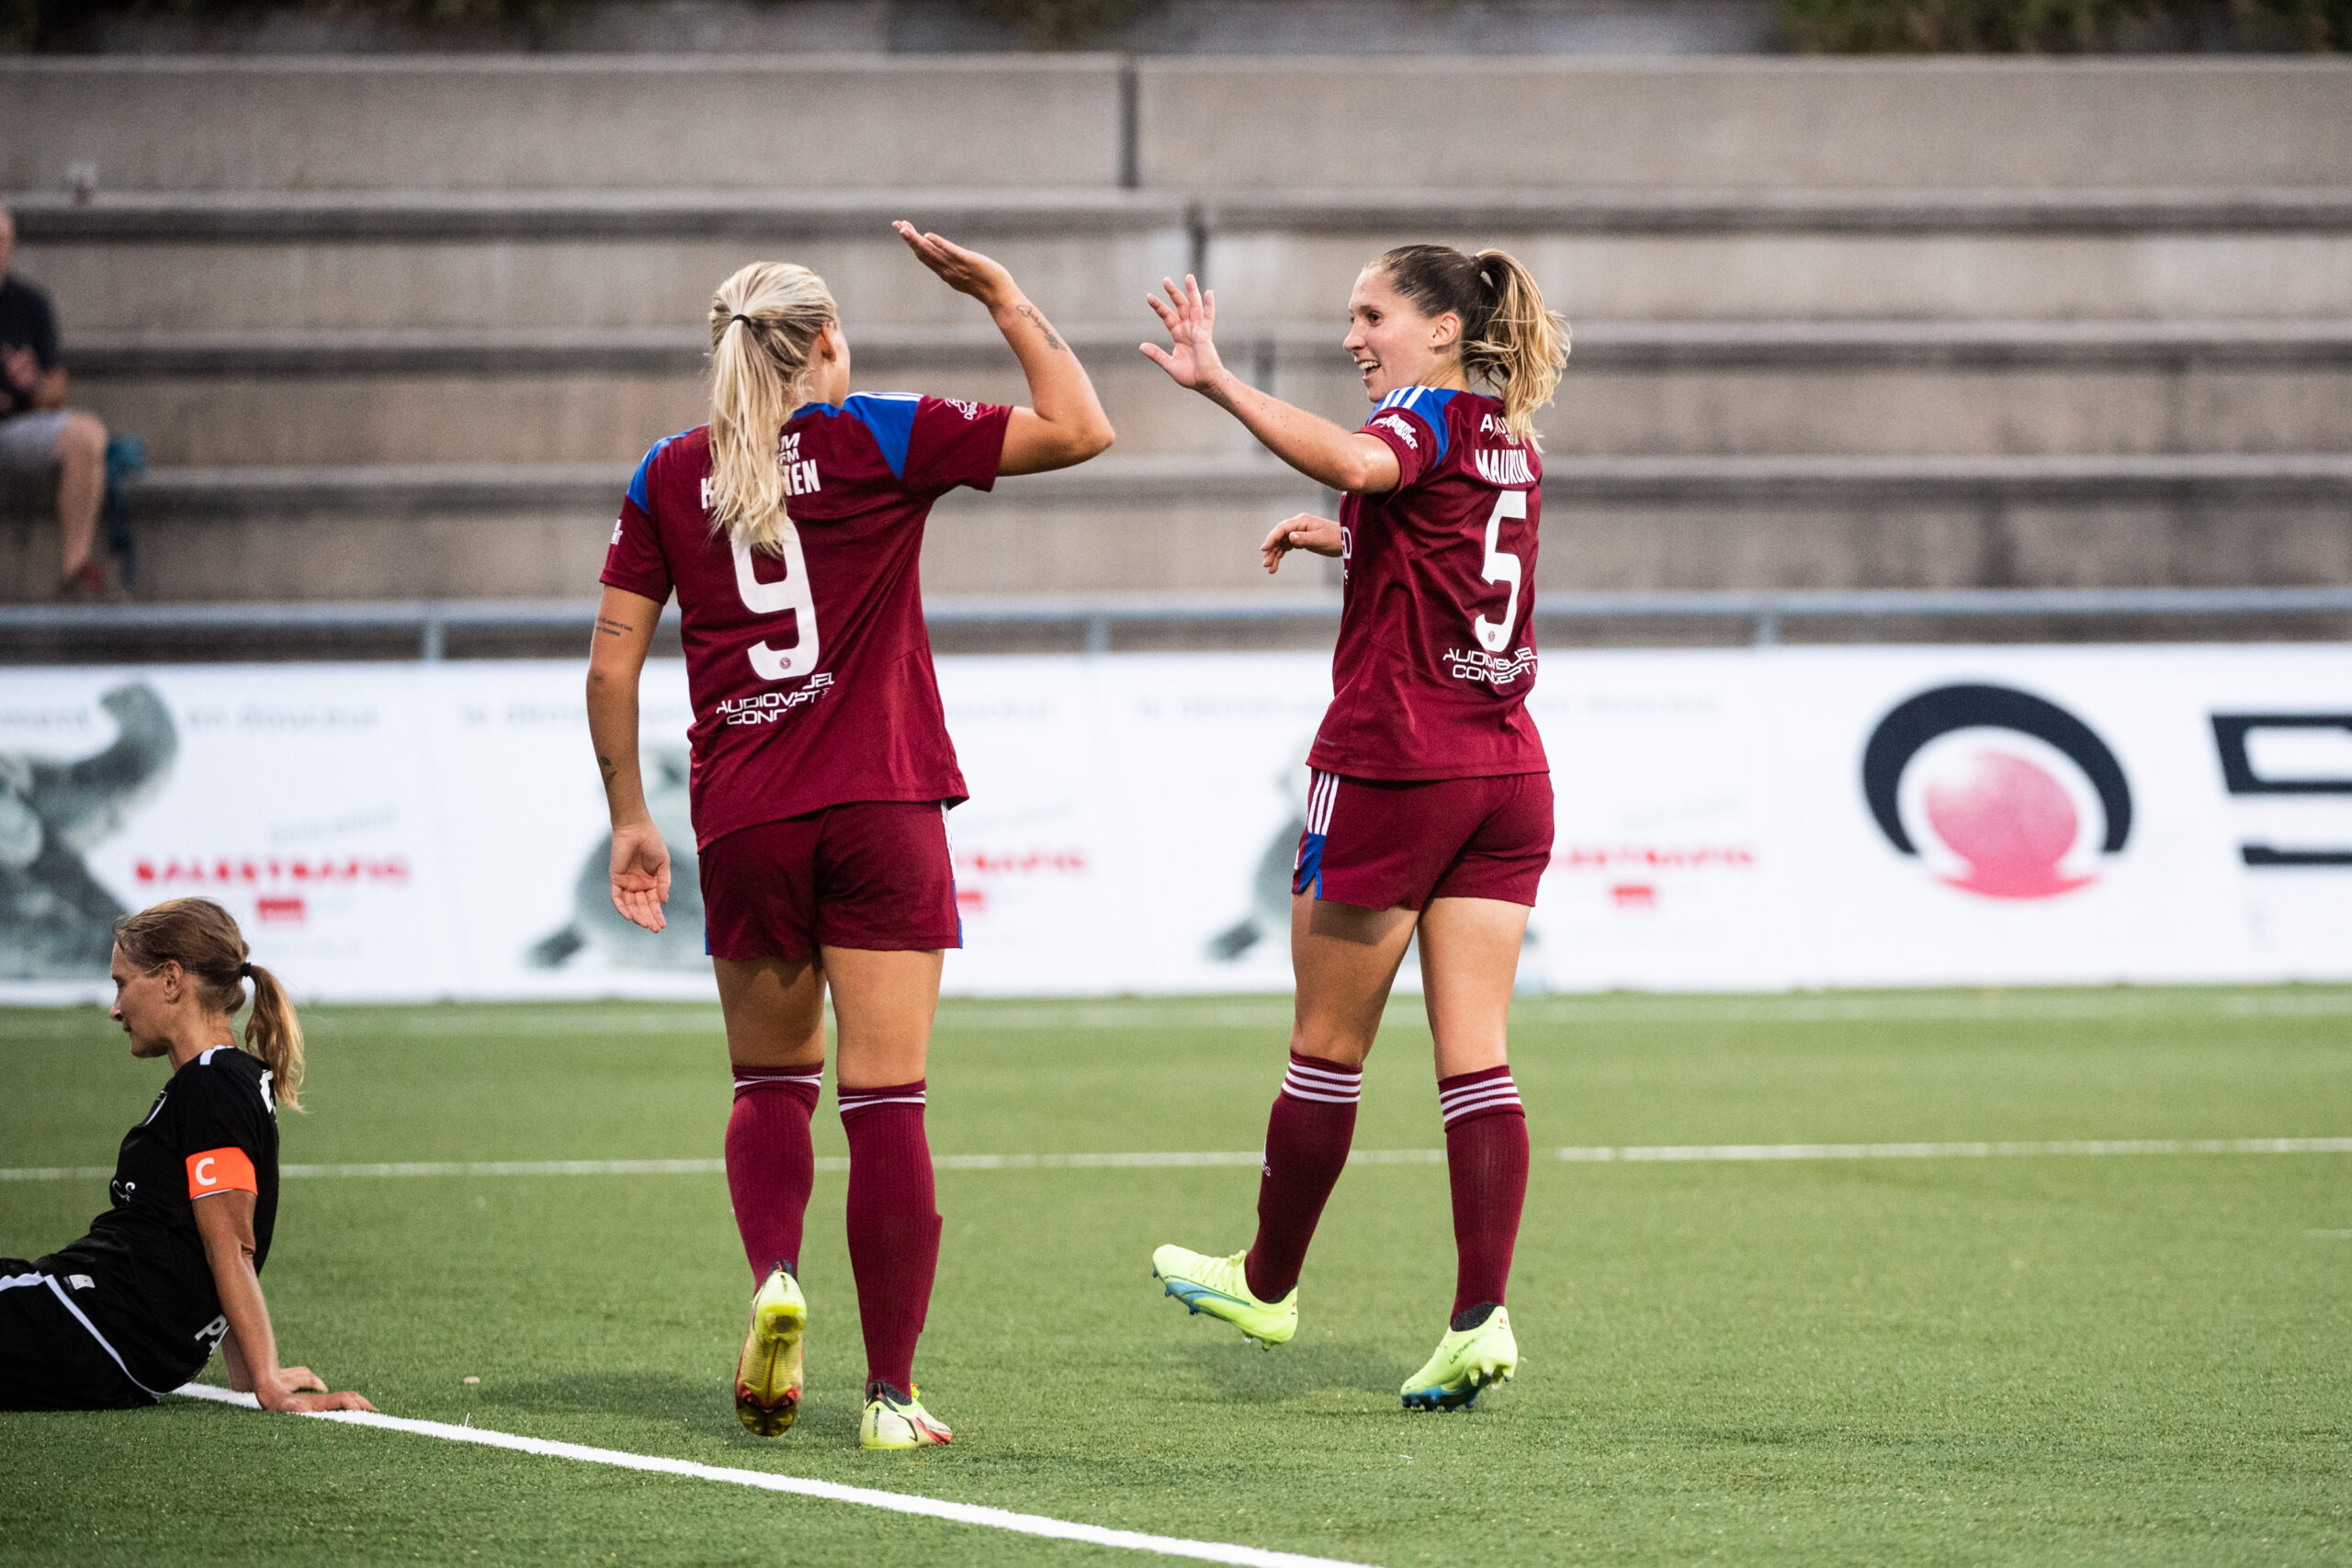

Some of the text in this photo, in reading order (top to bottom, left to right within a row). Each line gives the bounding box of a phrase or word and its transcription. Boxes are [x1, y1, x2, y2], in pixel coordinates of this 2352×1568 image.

[730, 507, 820, 681] 9
[1475, 490, 1527, 653] 5
[195, 1157, 218, 1186] C
